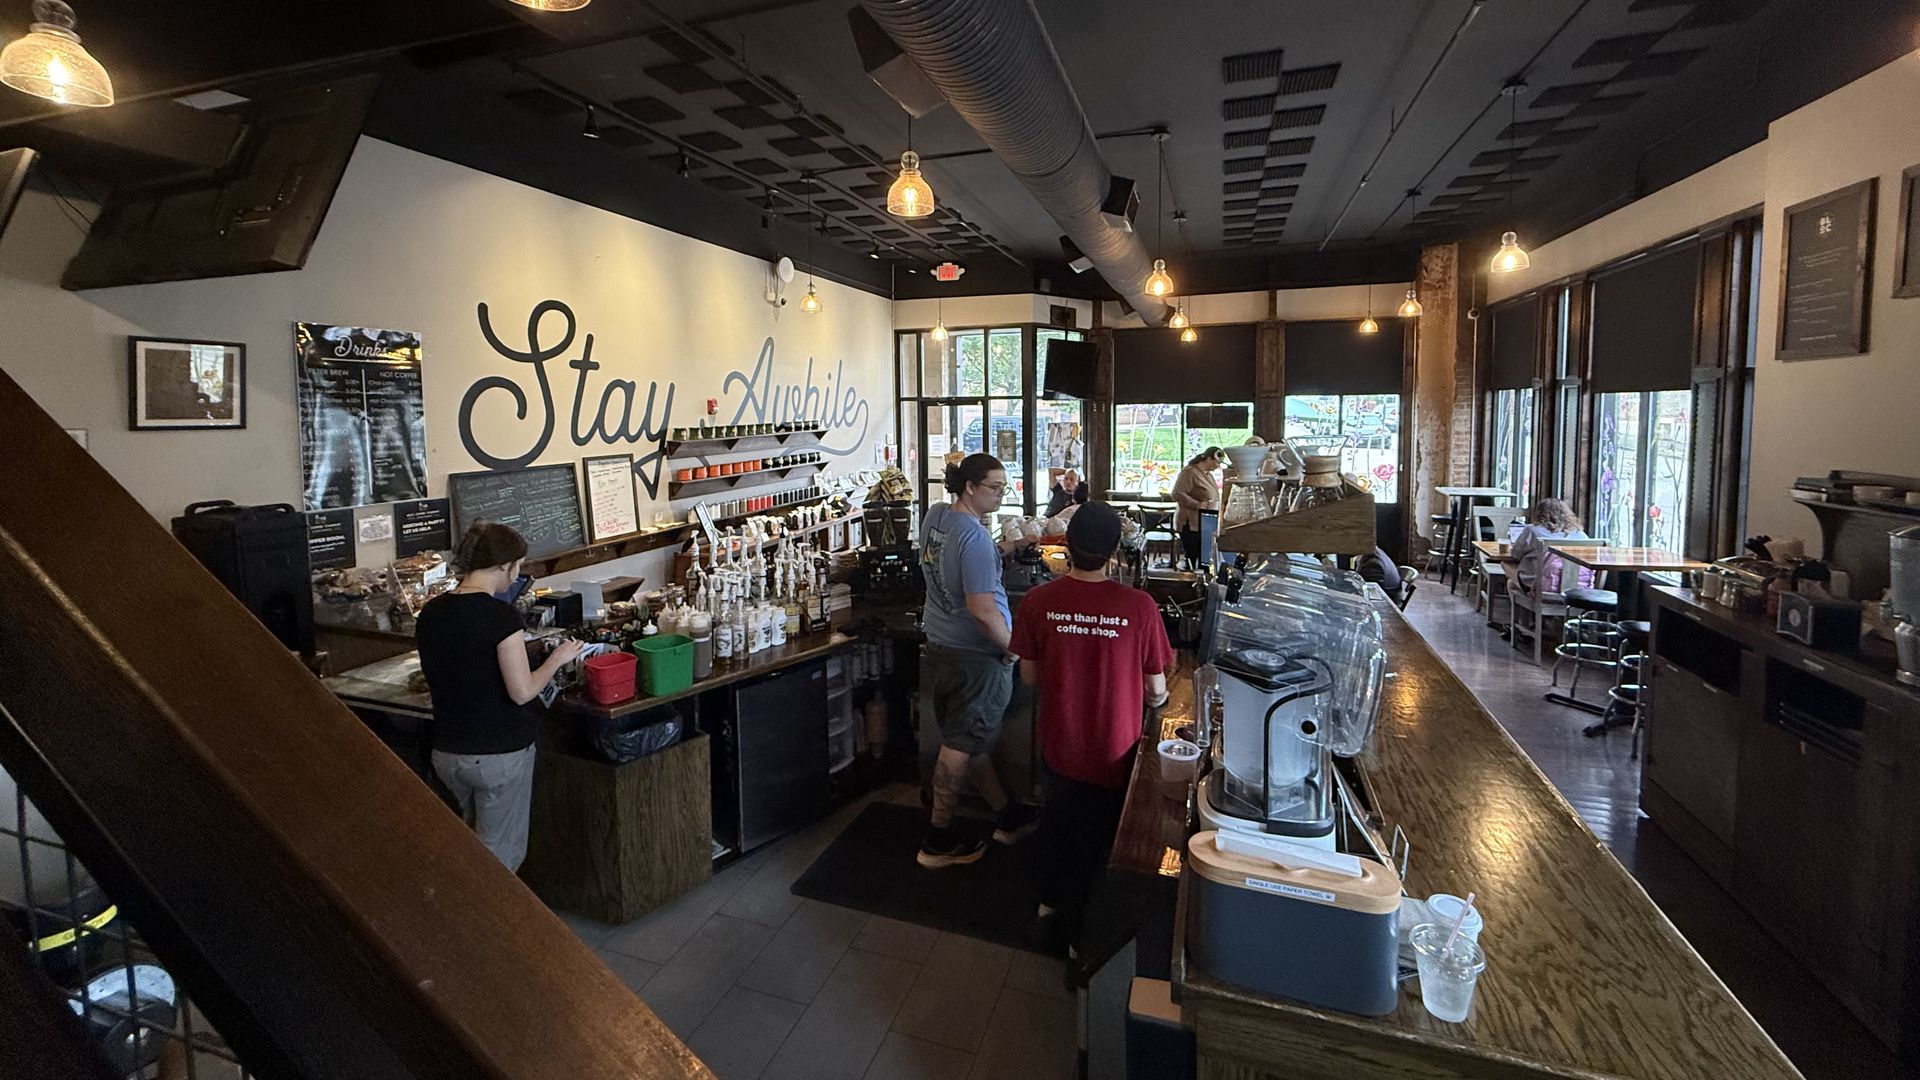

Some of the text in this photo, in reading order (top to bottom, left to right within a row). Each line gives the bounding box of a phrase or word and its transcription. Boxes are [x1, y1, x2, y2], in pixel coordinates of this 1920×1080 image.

[334, 335, 389, 358] Drinks
[458, 299, 676, 501] Stay
[702, 336, 869, 457] Awhile
[1046, 611, 1129, 626] More than just a
[1056, 624, 1120, 638] coffee shop.
[1248, 879, 1324, 899] SINGLE USE PAPER TOWEL
